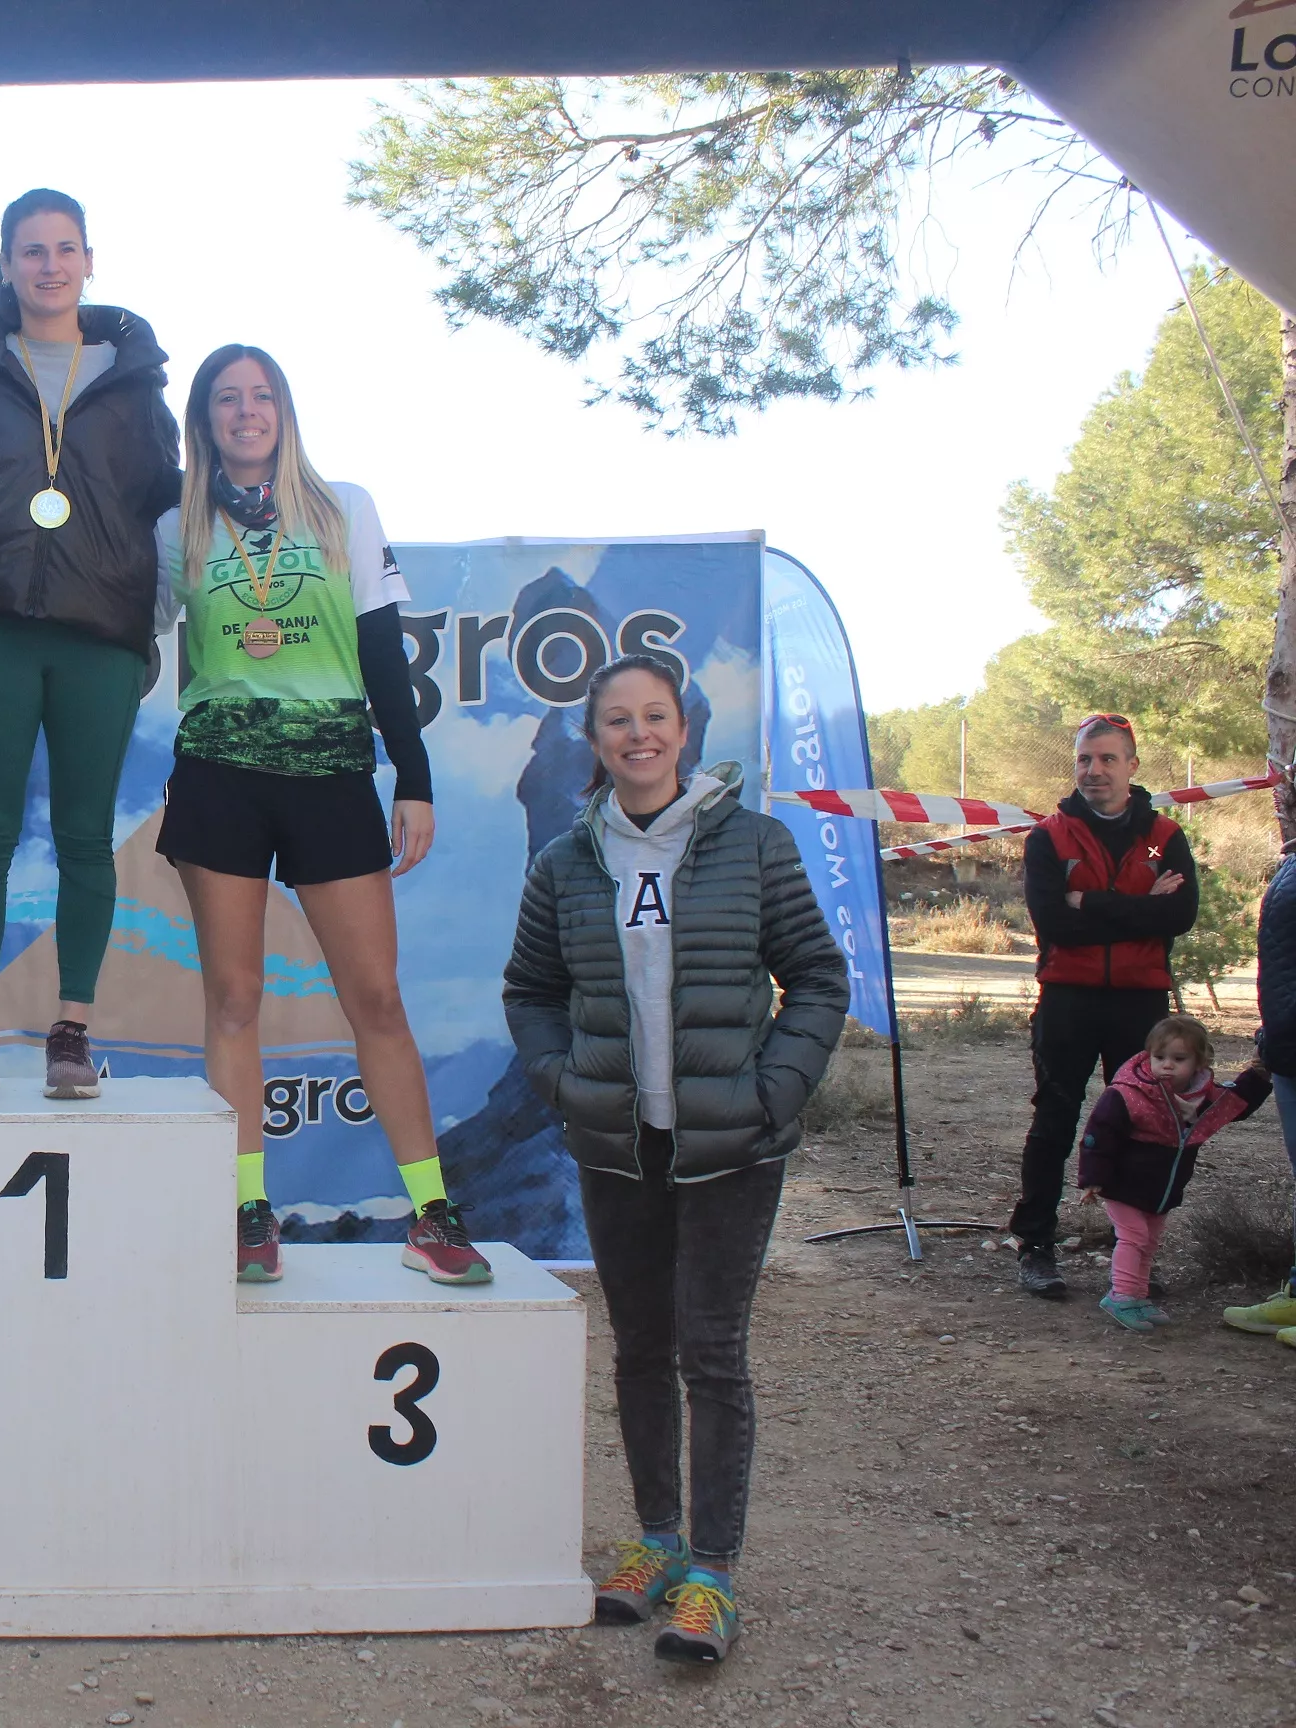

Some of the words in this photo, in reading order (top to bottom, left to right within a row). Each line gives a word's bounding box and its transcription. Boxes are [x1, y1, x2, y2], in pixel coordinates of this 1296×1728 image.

[222, 623, 241, 636] DE
[280, 632, 311, 645] ESA
[624, 871, 671, 929] A
[367, 1342, 441, 1467] 3
